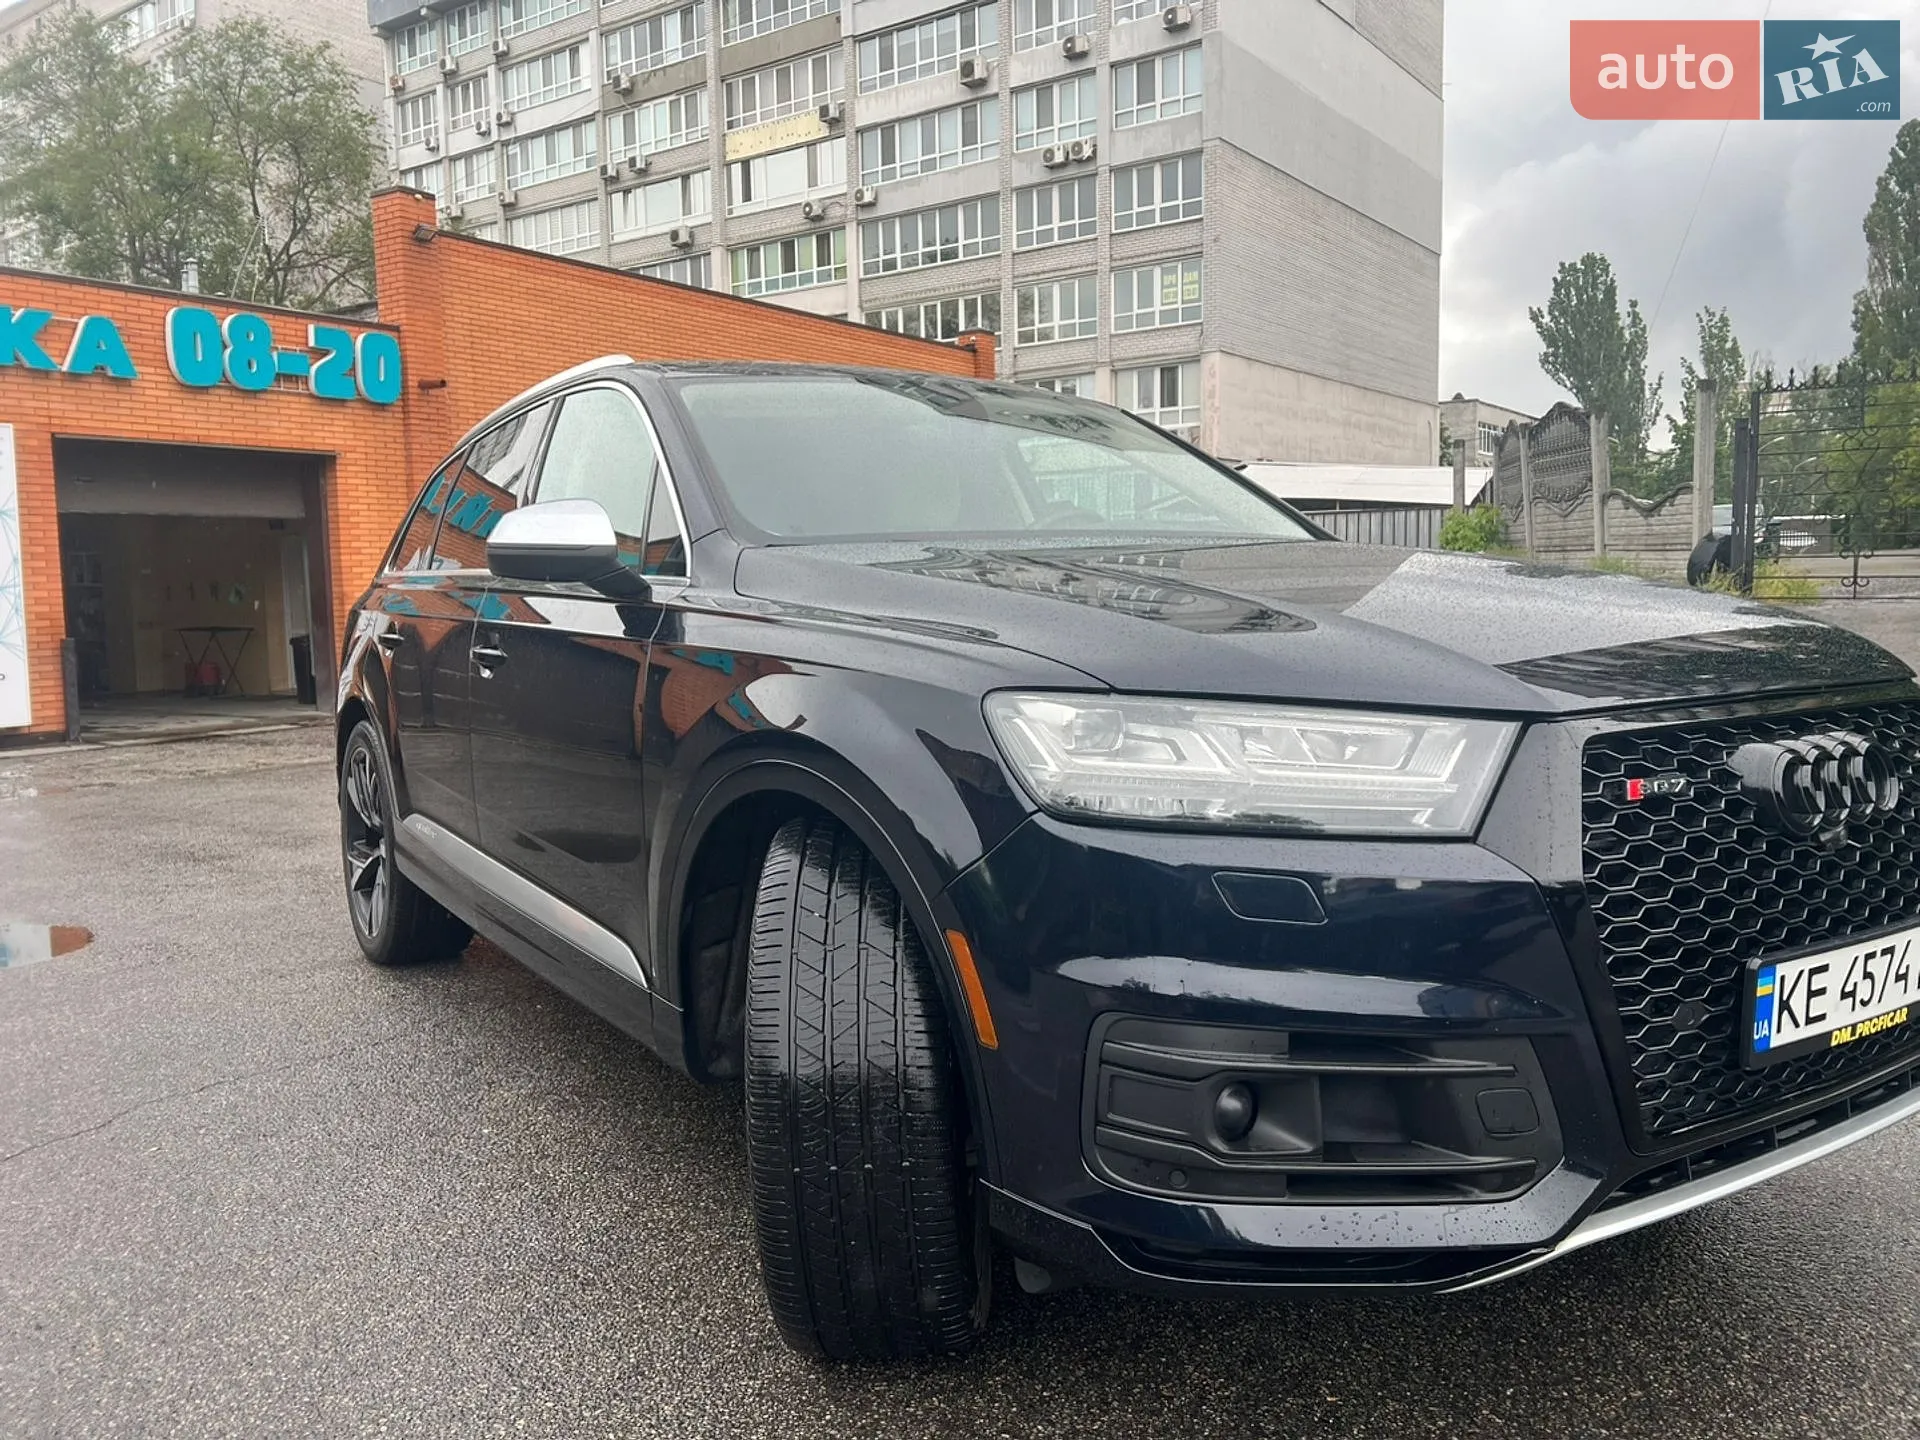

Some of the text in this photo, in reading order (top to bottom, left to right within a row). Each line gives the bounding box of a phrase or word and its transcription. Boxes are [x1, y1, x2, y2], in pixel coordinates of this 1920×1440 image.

[165, 306, 402, 405] 08-20
[1753, 1018, 1770, 1040] UA
[1776, 963, 1830, 1034] KE
[1840, 939, 1912, 1012] 4574
